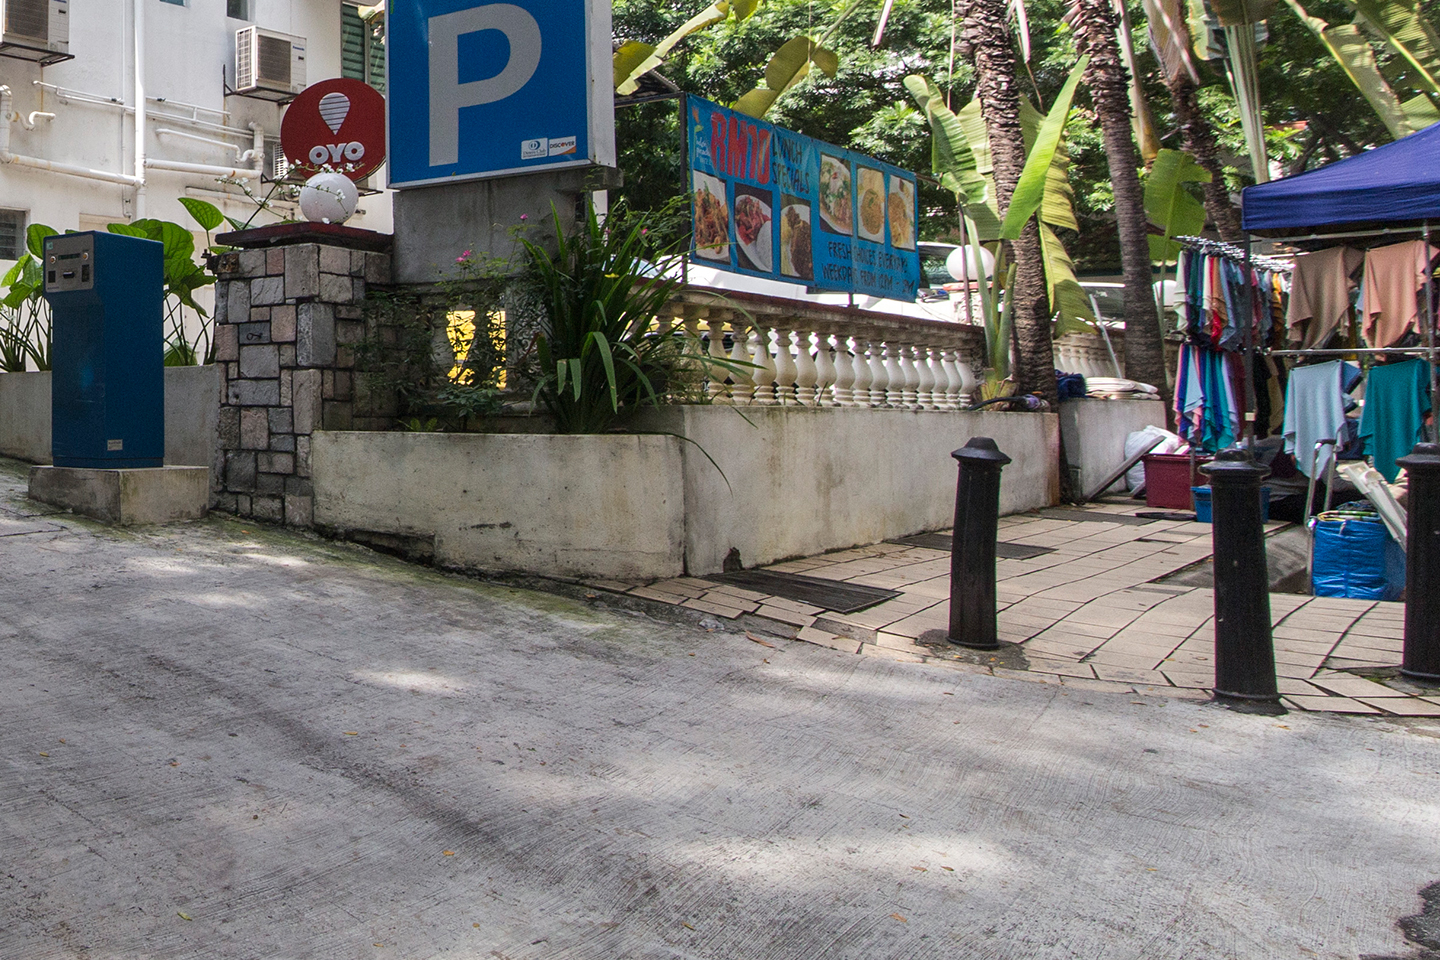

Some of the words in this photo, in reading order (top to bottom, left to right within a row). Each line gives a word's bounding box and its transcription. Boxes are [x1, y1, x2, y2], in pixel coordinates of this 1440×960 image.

[428, 3, 542, 167] P
[309, 141, 365, 165] OYO
[550, 140, 575, 149] DISCOVER
[711, 111, 770, 185] RM10
[772, 133, 803, 164] LUNCH
[772, 161, 810, 195] SPECIALS
[828, 241, 852, 260] FRESH
[860, 270, 876, 287] FROM
